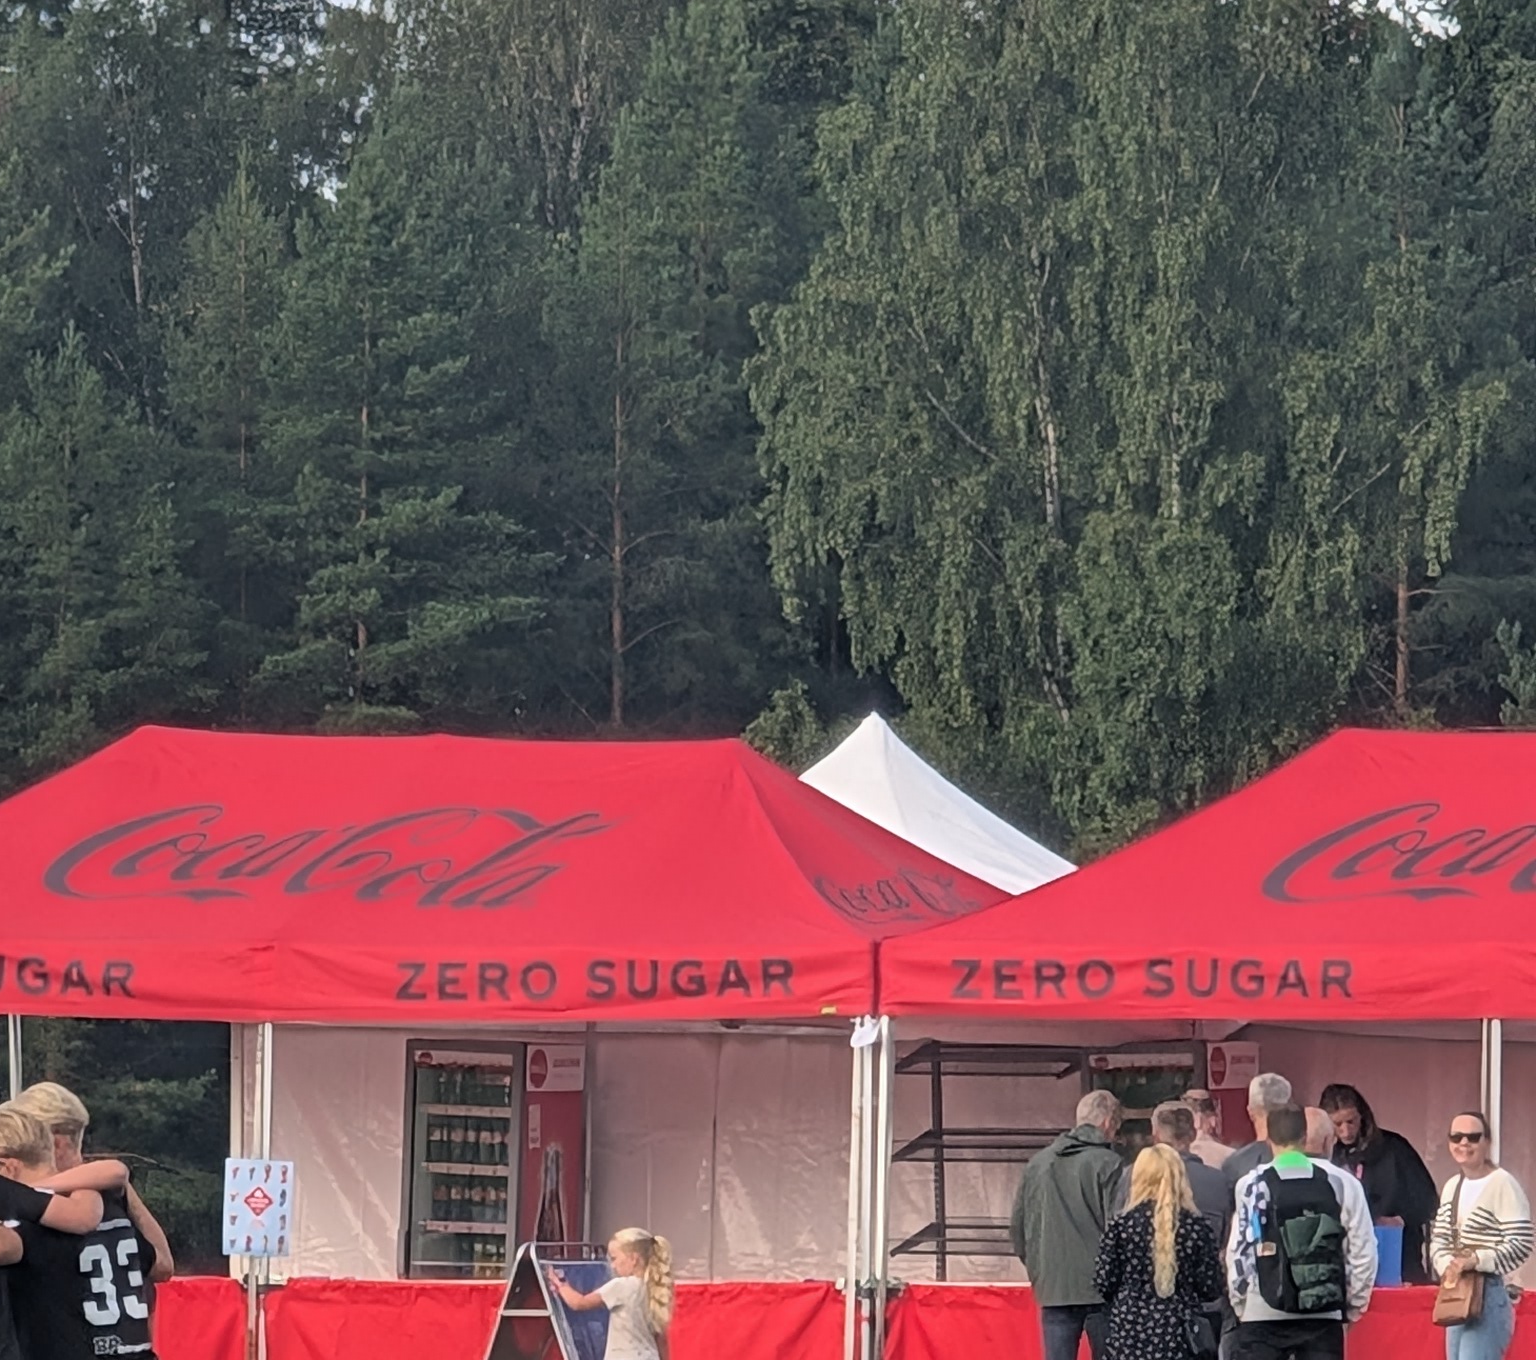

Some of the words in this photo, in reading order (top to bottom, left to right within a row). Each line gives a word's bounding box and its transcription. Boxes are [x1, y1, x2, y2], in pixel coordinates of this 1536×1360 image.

[42, 803, 616, 908] Coca-Cola
[1261, 802, 1536, 903] Coca
[395, 961, 558, 1001] ZERO
[586, 958, 796, 1001] SUGAR
[950, 959, 1116, 999] ZERO
[1143, 958, 1354, 999] SUGAR
[79, 1237, 149, 1326] 33
